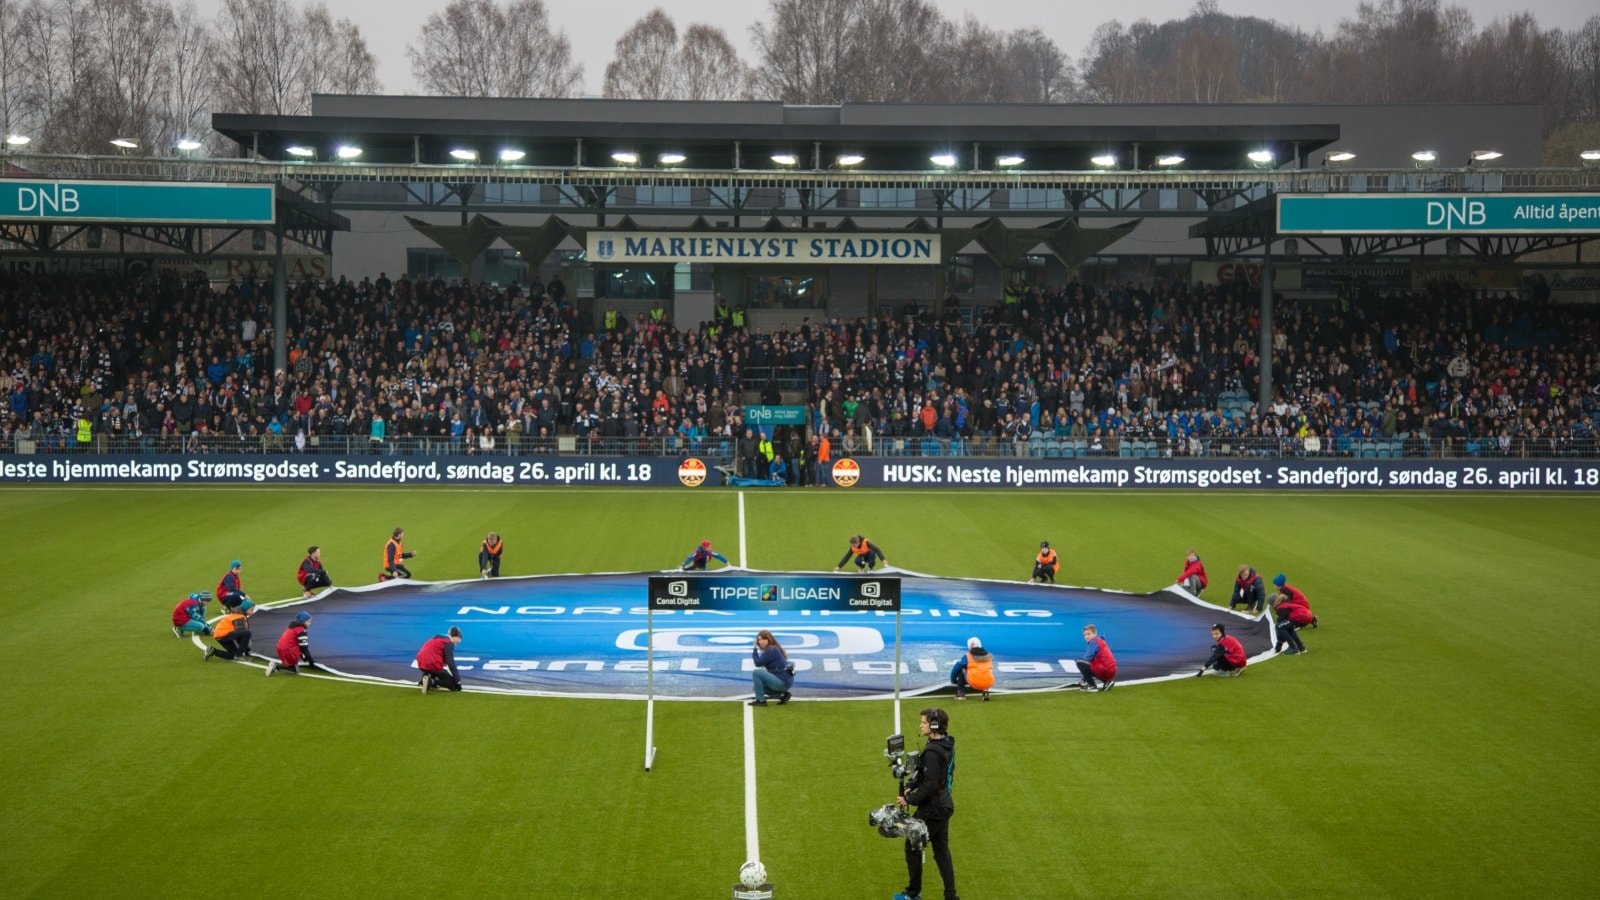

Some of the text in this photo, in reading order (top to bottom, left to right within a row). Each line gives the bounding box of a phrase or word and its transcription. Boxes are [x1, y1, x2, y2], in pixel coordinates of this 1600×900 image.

[18, 183, 80, 217] DNB
[1427, 196, 1487, 230] DNB
[1513, 204, 1555, 219] Alltid
[624, 237, 933, 259] MARIENLYST STADION
[750, 405, 772, 424] DNB
[53, 460, 183, 481] hjemmekamp
[187, 460, 319, 481] Strømsgodset
[335, 461, 442, 482] Sandefjord,
[446, 462, 515, 482] søndag
[519, 463, 550, 479] 26.
[554, 463, 595, 483] april
[599, 463, 622, 480] kl.
[627, 464, 652, 481] 18
[883, 465, 942, 482] HUSK:
[947, 466, 1002, 483] Neste
[1006, 466, 1129, 487] hjemmekamp
[1133, 466, 1262, 487] Strømsgodset
[1277, 467, 1384, 488] Sandefjord,
[1388, 467, 1458, 488] søndag
[1462, 468, 1493, 485] 26.
[1498, 468, 1540, 489] april
[1545, 468, 1568, 485] kl.
[1574, 469, 1599, 486] 18
[656, 597, 700, 606] Canal Digital
[709, 587, 841, 600] TIPPE LIGAEN
[849, 598, 893, 607] Canal Digital
[741, 657, 1080, 675] Digial
